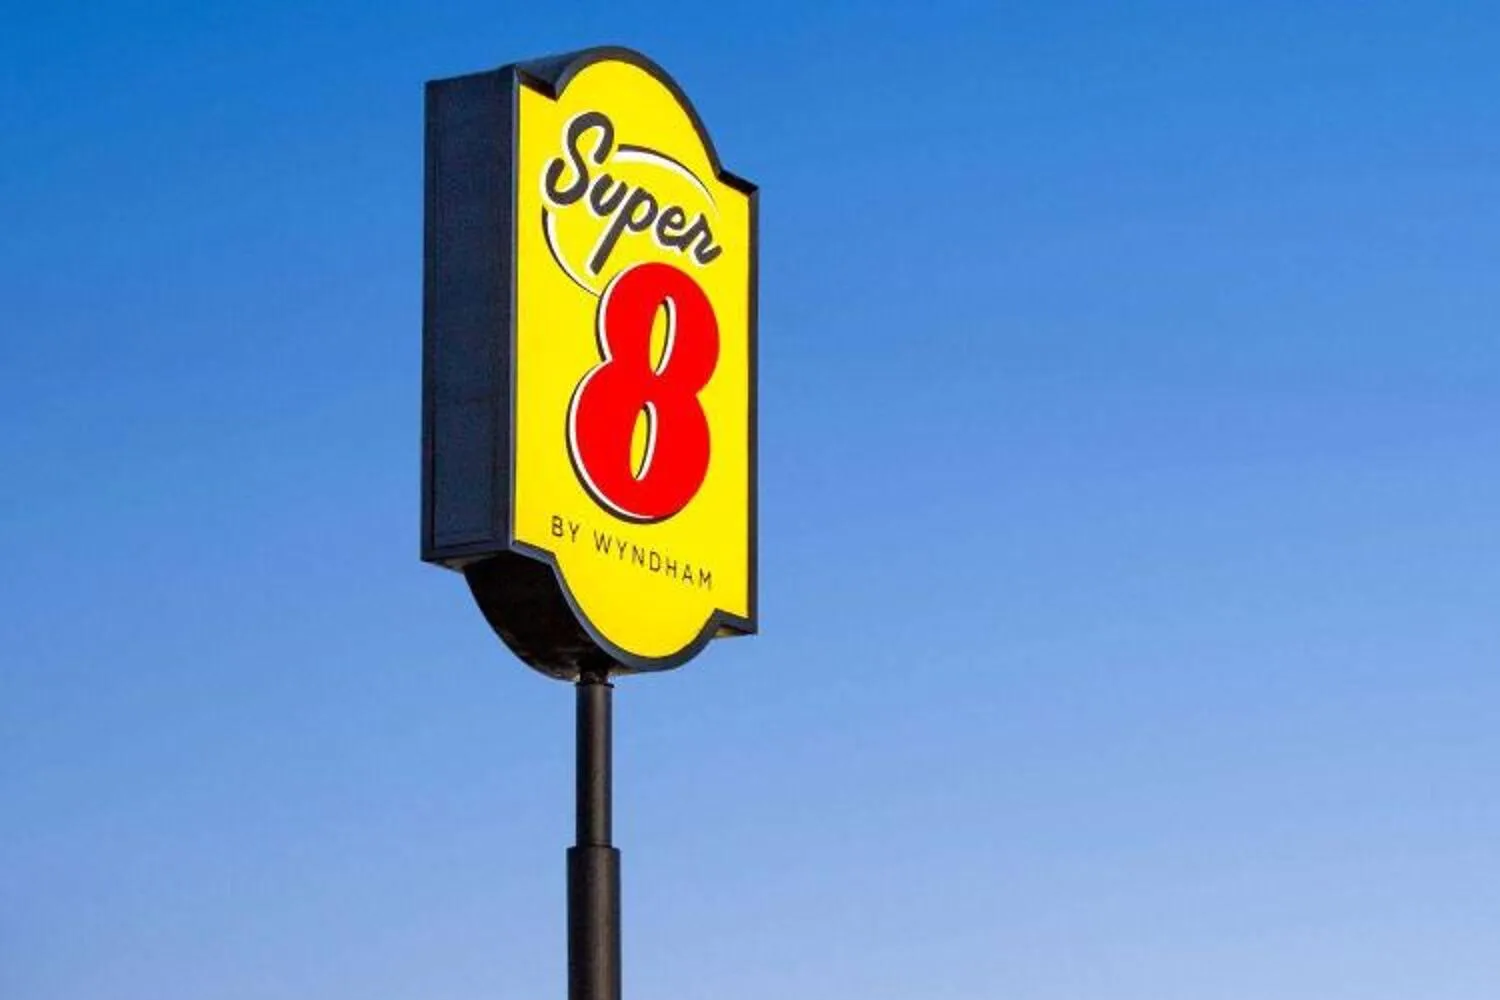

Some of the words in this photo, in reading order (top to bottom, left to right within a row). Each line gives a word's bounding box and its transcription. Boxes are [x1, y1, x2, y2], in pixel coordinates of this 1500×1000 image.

[545, 111, 722, 275] Super
[567, 262, 720, 524] 8
[551, 515, 581, 544] BY
[593, 530, 714, 592] WYNDHAM
